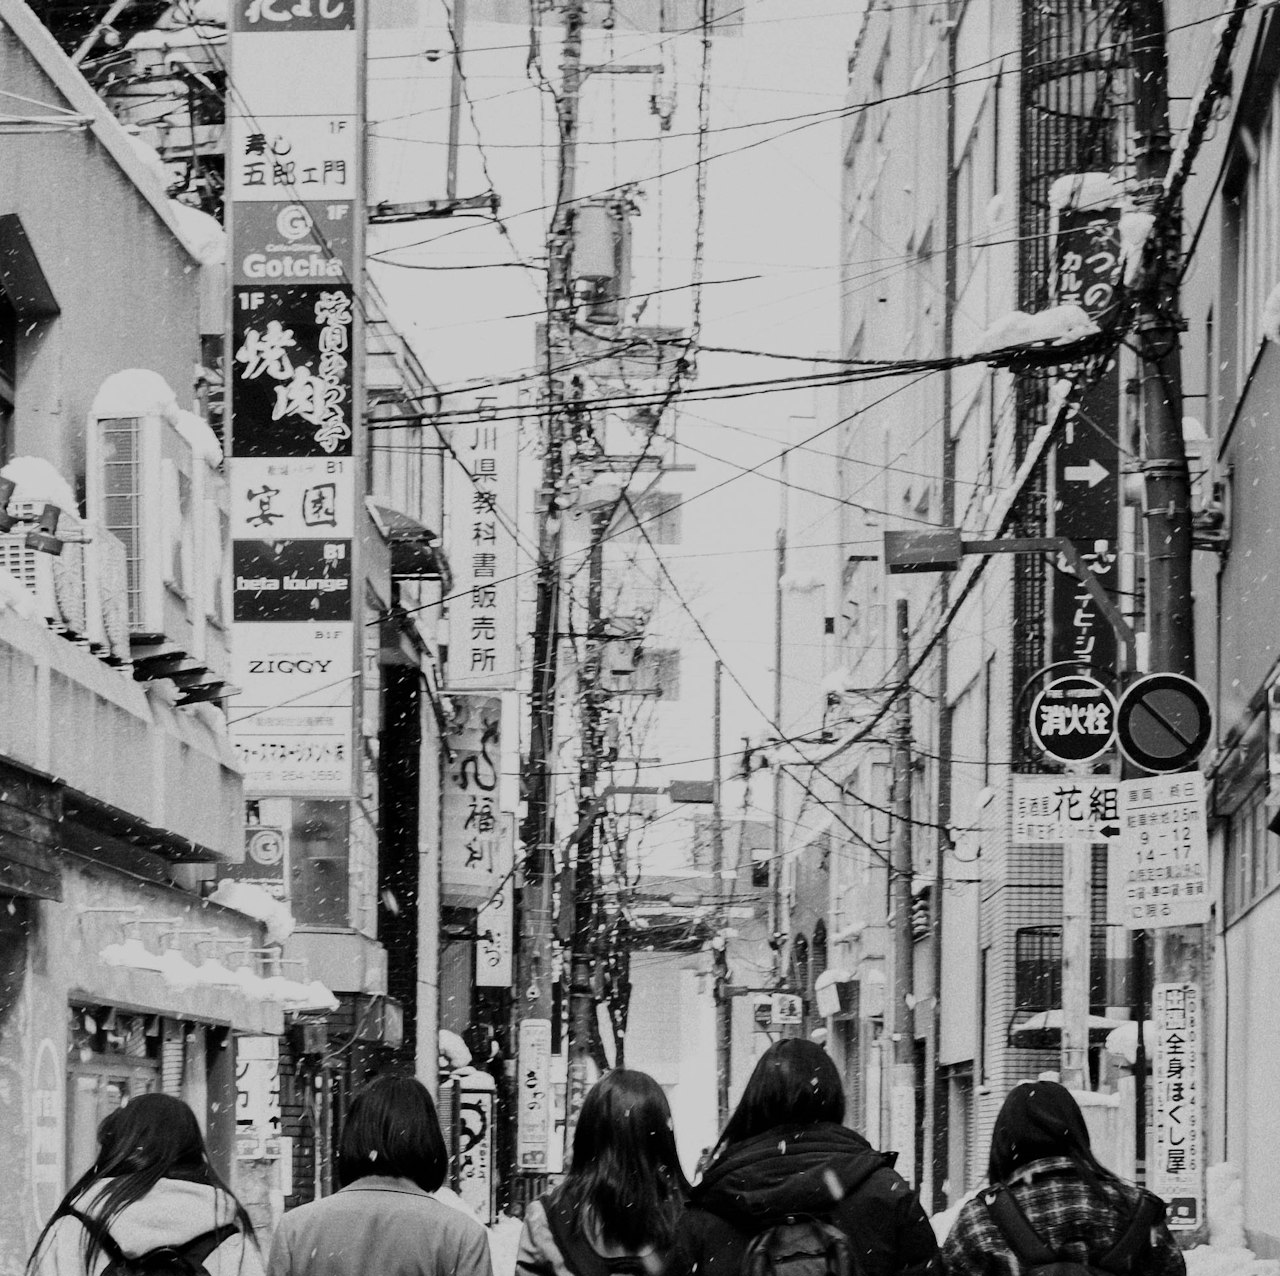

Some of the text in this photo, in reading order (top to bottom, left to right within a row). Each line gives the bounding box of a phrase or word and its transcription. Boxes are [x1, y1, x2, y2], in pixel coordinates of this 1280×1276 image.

[329, 121, 348, 134] 1F
[326, 205, 349, 220] 1F
[242, 253, 343, 278] Gotcha
[238, 292, 265, 310] 1F
[236, 319, 328, 426] 焼肉
[470, 396, 498, 672] 石川県教科書販売所
[236, 576, 349, 592] beta lounge
[249, 660, 332, 674] ZIGGY
[1041, 703, 1111, 736] 消火栓
[1051, 785, 1120, 822] 花組
